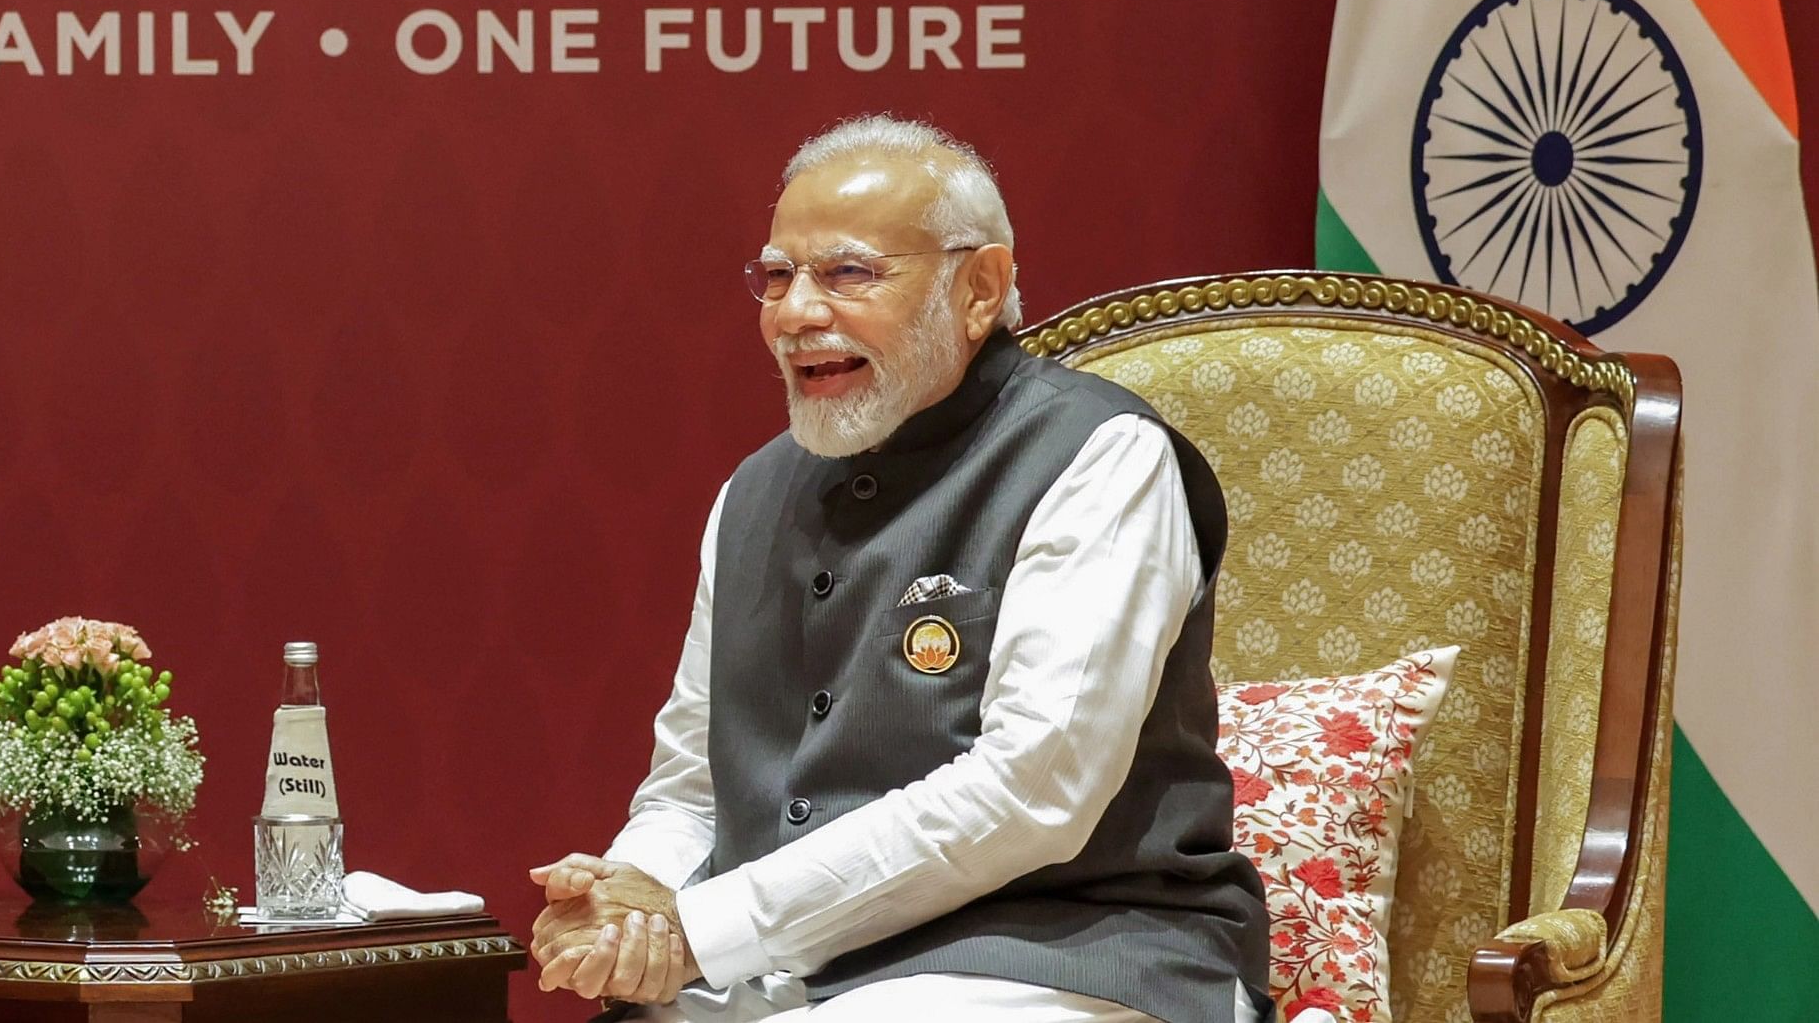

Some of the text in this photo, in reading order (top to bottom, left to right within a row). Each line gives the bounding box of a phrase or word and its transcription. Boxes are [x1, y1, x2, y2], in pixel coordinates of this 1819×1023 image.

[396, 9, 599, 74] ONE
[645, 5, 1025, 72] FUTURE
[273, 752, 325, 769] Water
[279, 778, 326, 798] (Still)
